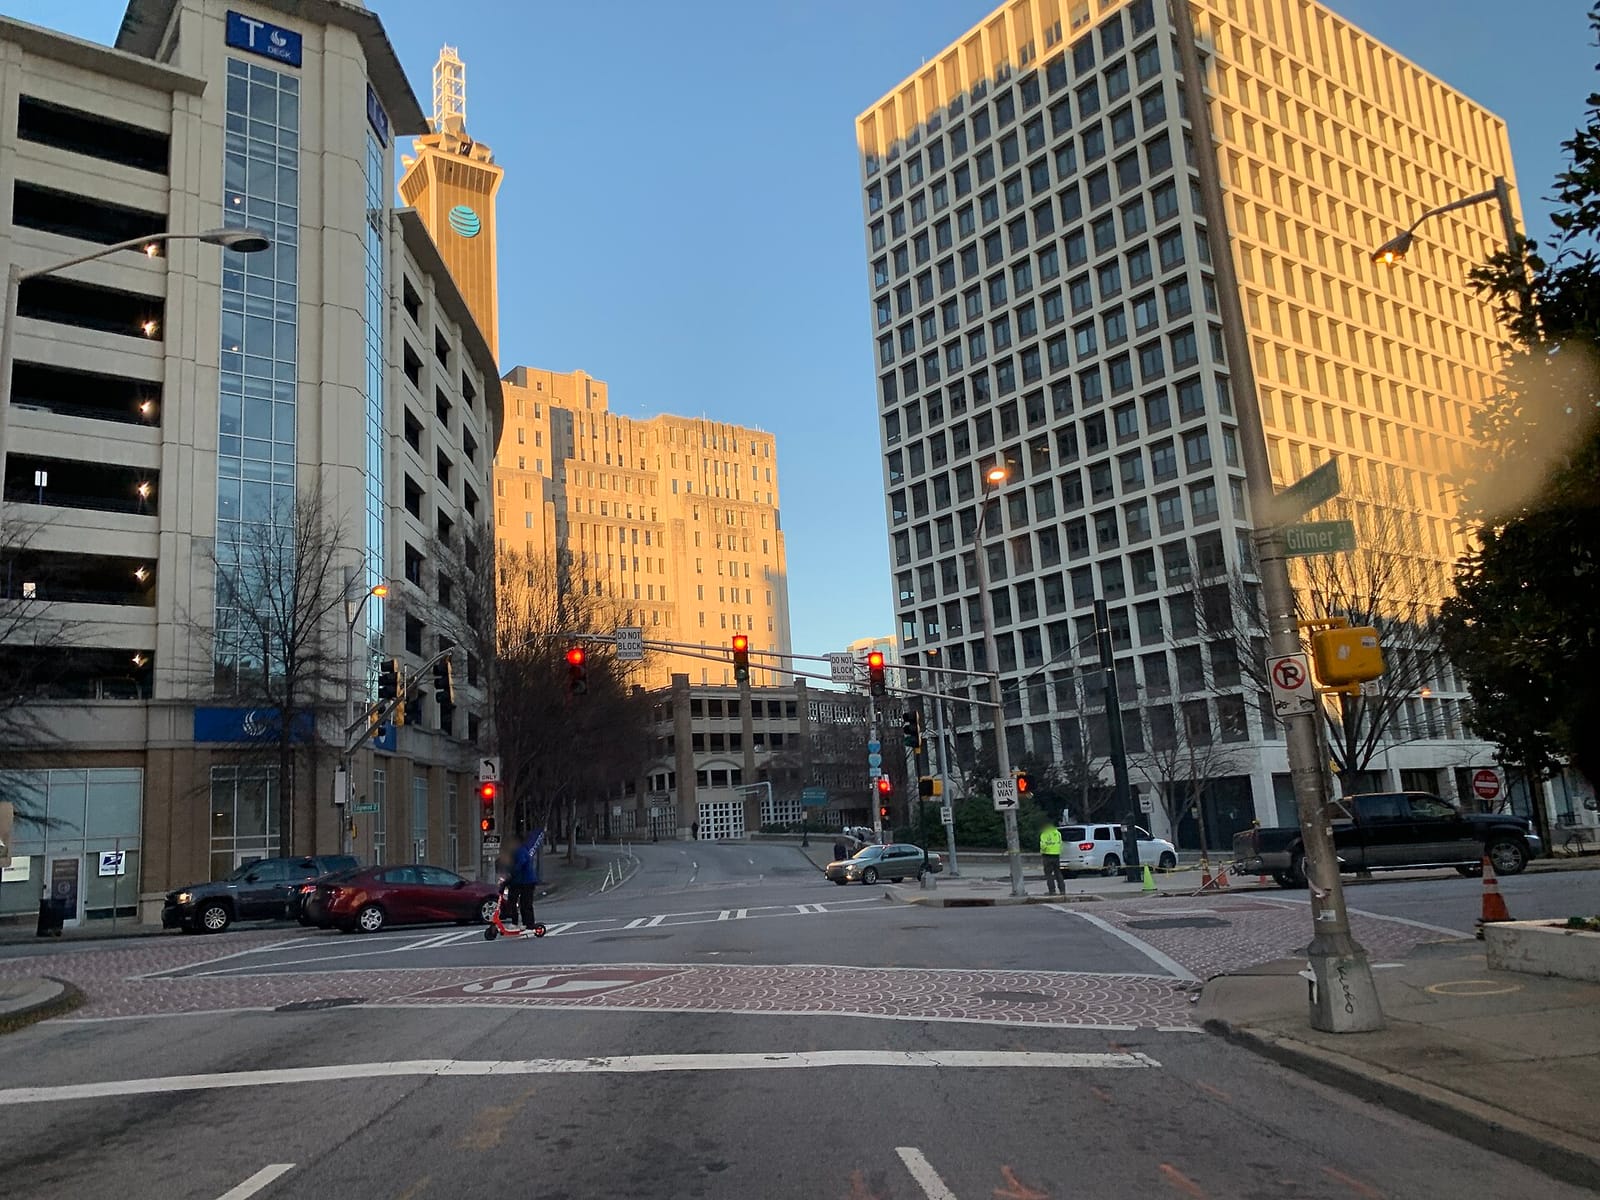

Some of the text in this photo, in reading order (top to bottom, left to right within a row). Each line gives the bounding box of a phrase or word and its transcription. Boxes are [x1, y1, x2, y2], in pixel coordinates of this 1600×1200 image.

[240, 16, 264, 47] T
[267, 46, 291, 58] DECK
[1286, 528, 1334, 550] Gilmer
[617, 631, 641, 640] DO NOT
[617, 642, 641, 651] BLOCK
[831, 656, 852, 665] DO NOT
[832, 666, 852, 674] BLOCK
[996, 781, 1013, 789] ONE
[997, 789, 1014, 797] WAY
